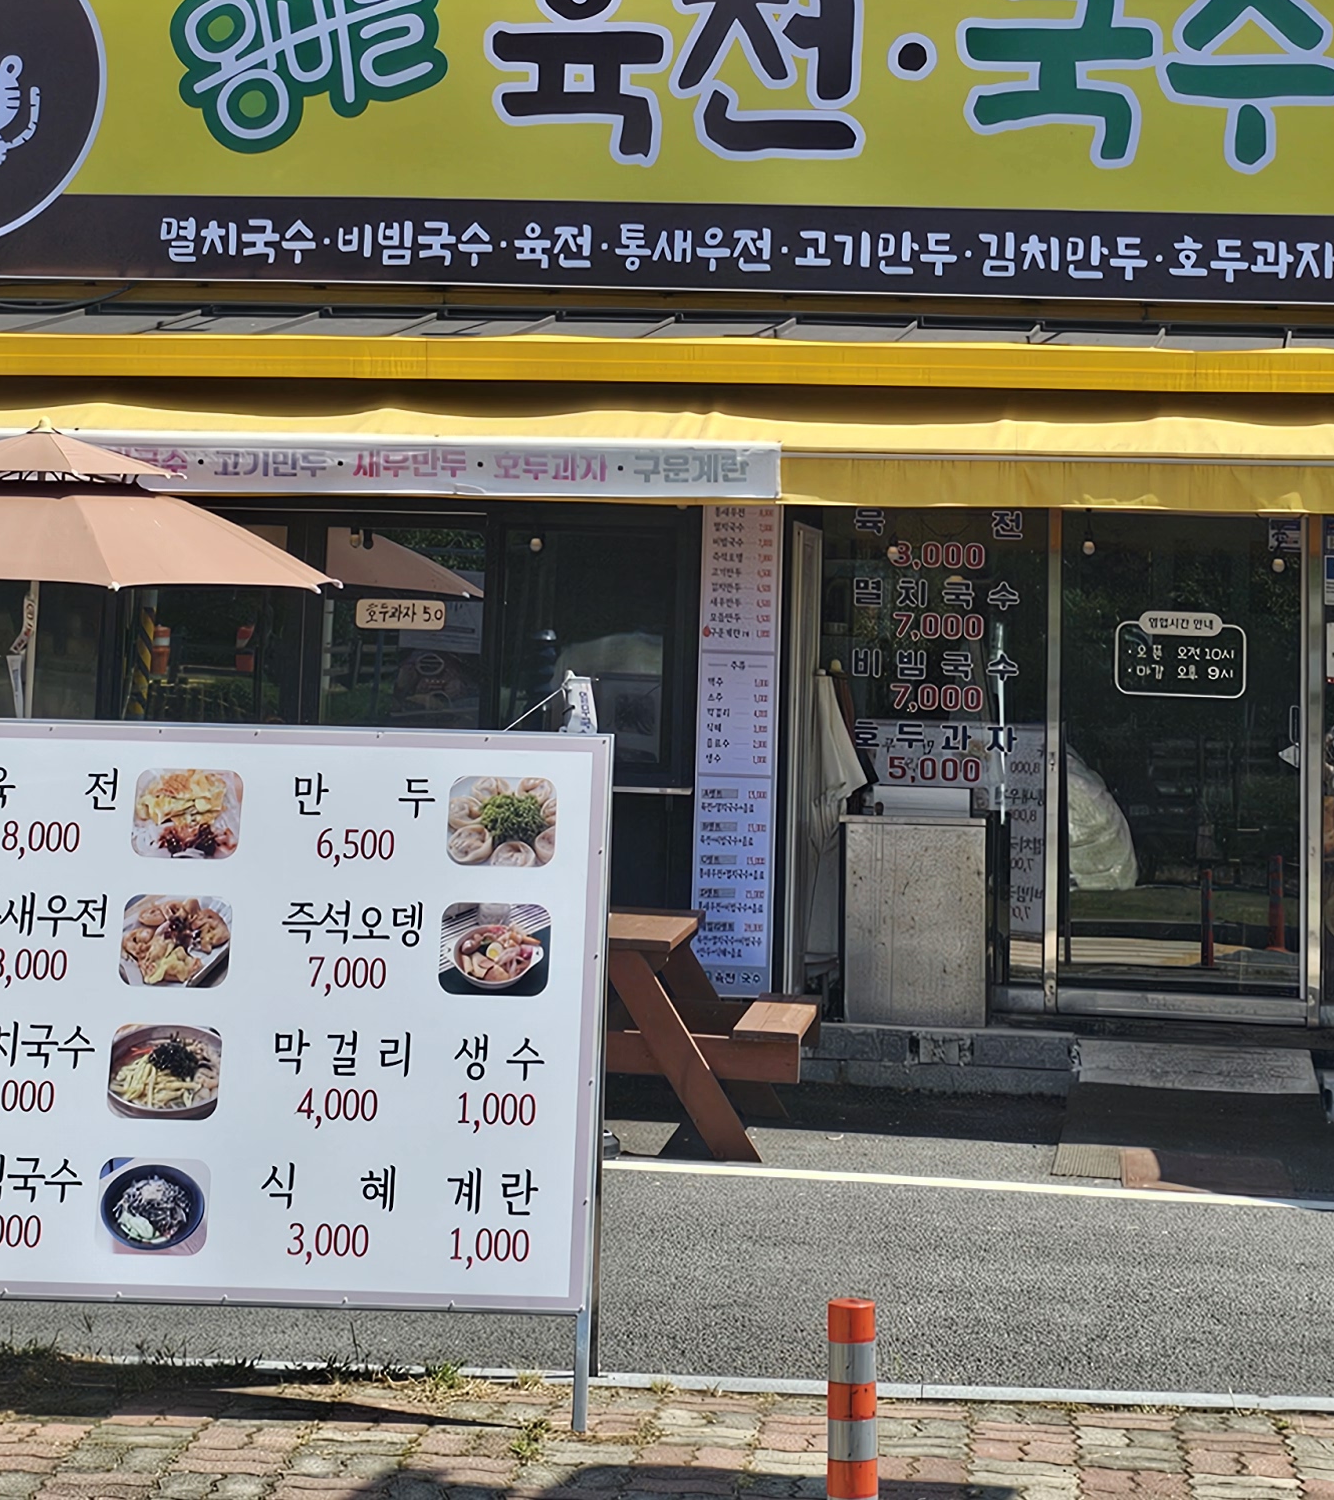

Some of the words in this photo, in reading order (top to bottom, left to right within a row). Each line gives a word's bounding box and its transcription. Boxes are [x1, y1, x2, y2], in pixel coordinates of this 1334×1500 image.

[161, 218, 316, 264] 멸치국수
[337, 220, 494, 268] 비빔국수
[514, 223, 592, 268] 육전
[615, 225, 773, 272] 통새우전
[795, 231, 958, 275] 고기만두
[979, 233, 1148, 280] 김치만두
[214, 449, 327, 477] 고기만두
[353, 448, 467, 478] 새우만두
[633, 450, 749, 484] 구운계란
[854, 508, 1023, 539] 육전
[854, 577, 1020, 610] 멸치국수
[366, 602, 417, 623] 호두과자
[893, 612, 985, 641] 7,000
[852, 648, 1019, 682] 비빔국수
[1177, 646, 1200, 660] 오전
[1205, 648, 1234, 660] 10시
[1136, 664, 1164, 680] 마감
[1207, 666, 1234, 680] 9시
[890, 683, 983, 713] 7,000
[854, 720, 1017, 753] 호두과자
[888, 755, 981, 784] 5,000
[294, 773, 436, 818] 만두
[0, 820, 80, 854] 8,000
[316, 828, 395, 866] 6,500
[281, 902, 424, 948] 즉석오뎅
[308, 956, 387, 995] 7,000
[274, 1029, 413, 1078] 막걸리
[454, 1033, 545, 1081] 생수
[296, 1088, 378, 1129] 4,000
[457, 1092, 537, 1132] 1,000
[261, 1163, 397, 1211] 식혜
[447, 1168, 539, 1217] 계란
[287, 1223, 369, 1263] 3,000
[449, 1227, 530, 1270] 1,000
